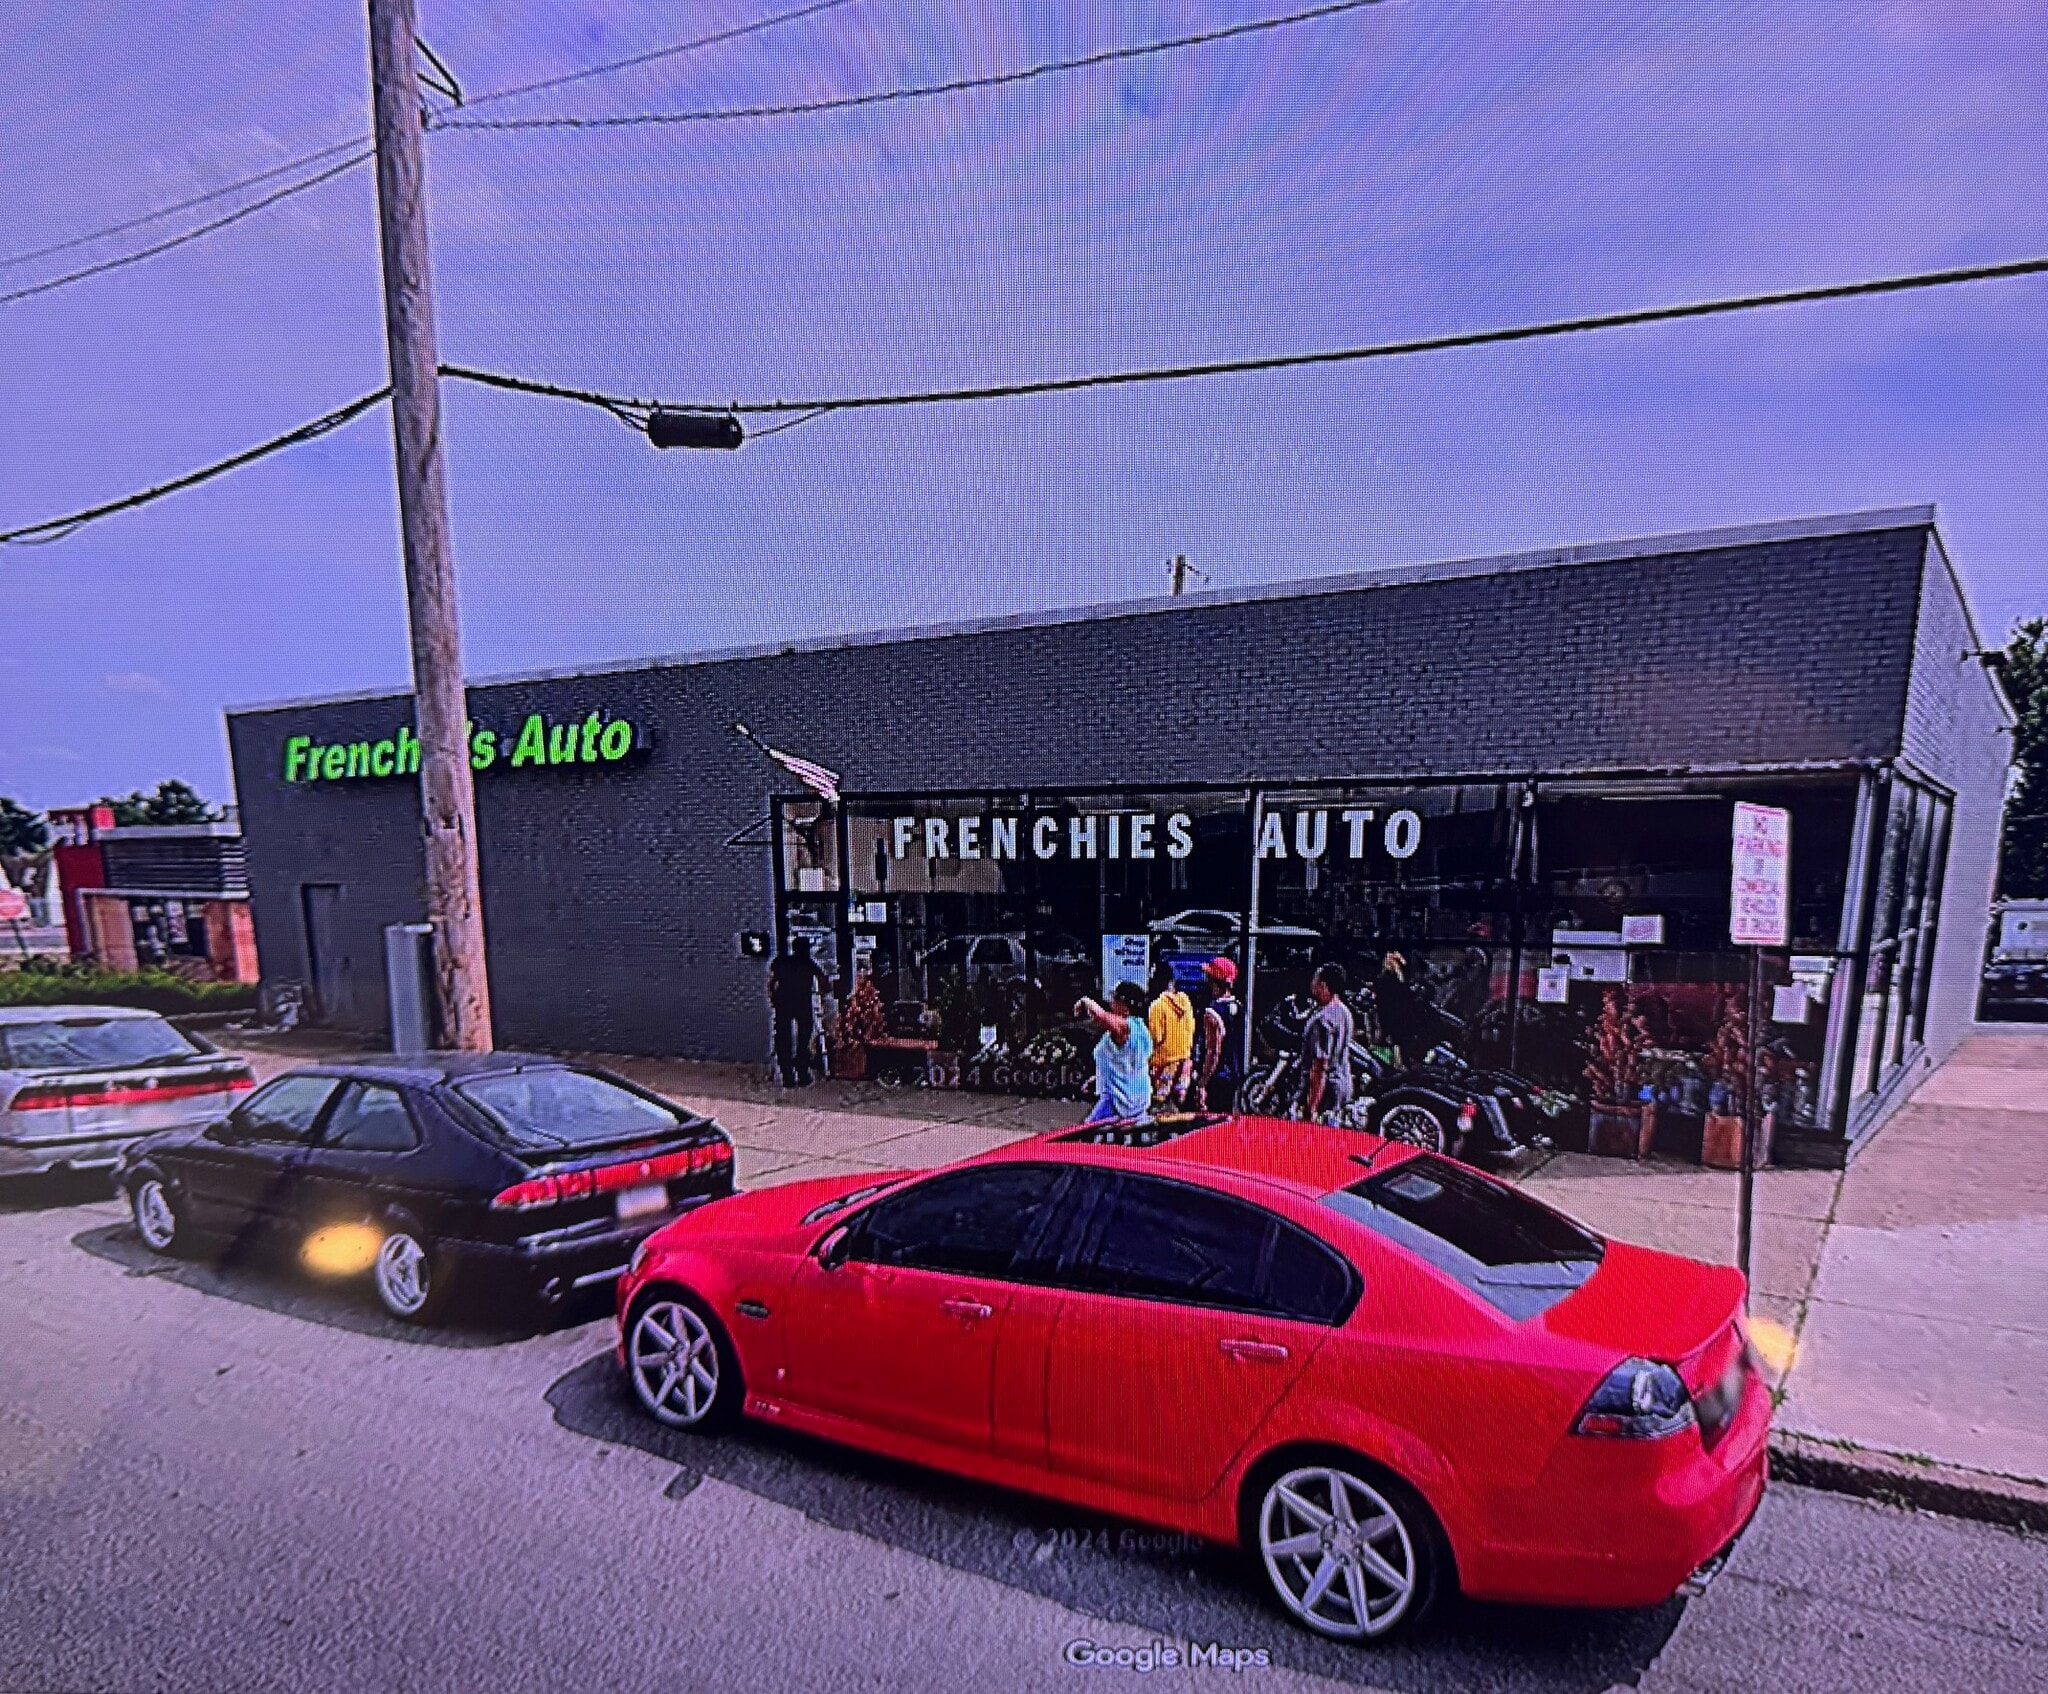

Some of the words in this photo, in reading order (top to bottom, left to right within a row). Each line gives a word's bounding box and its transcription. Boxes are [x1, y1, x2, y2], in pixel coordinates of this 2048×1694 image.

[284, 720, 497, 783] French's
[511, 712, 633, 767] Auto
[892, 812, 1194, 860] FRENCHIES
[1256, 809, 1422, 859] AUTO
